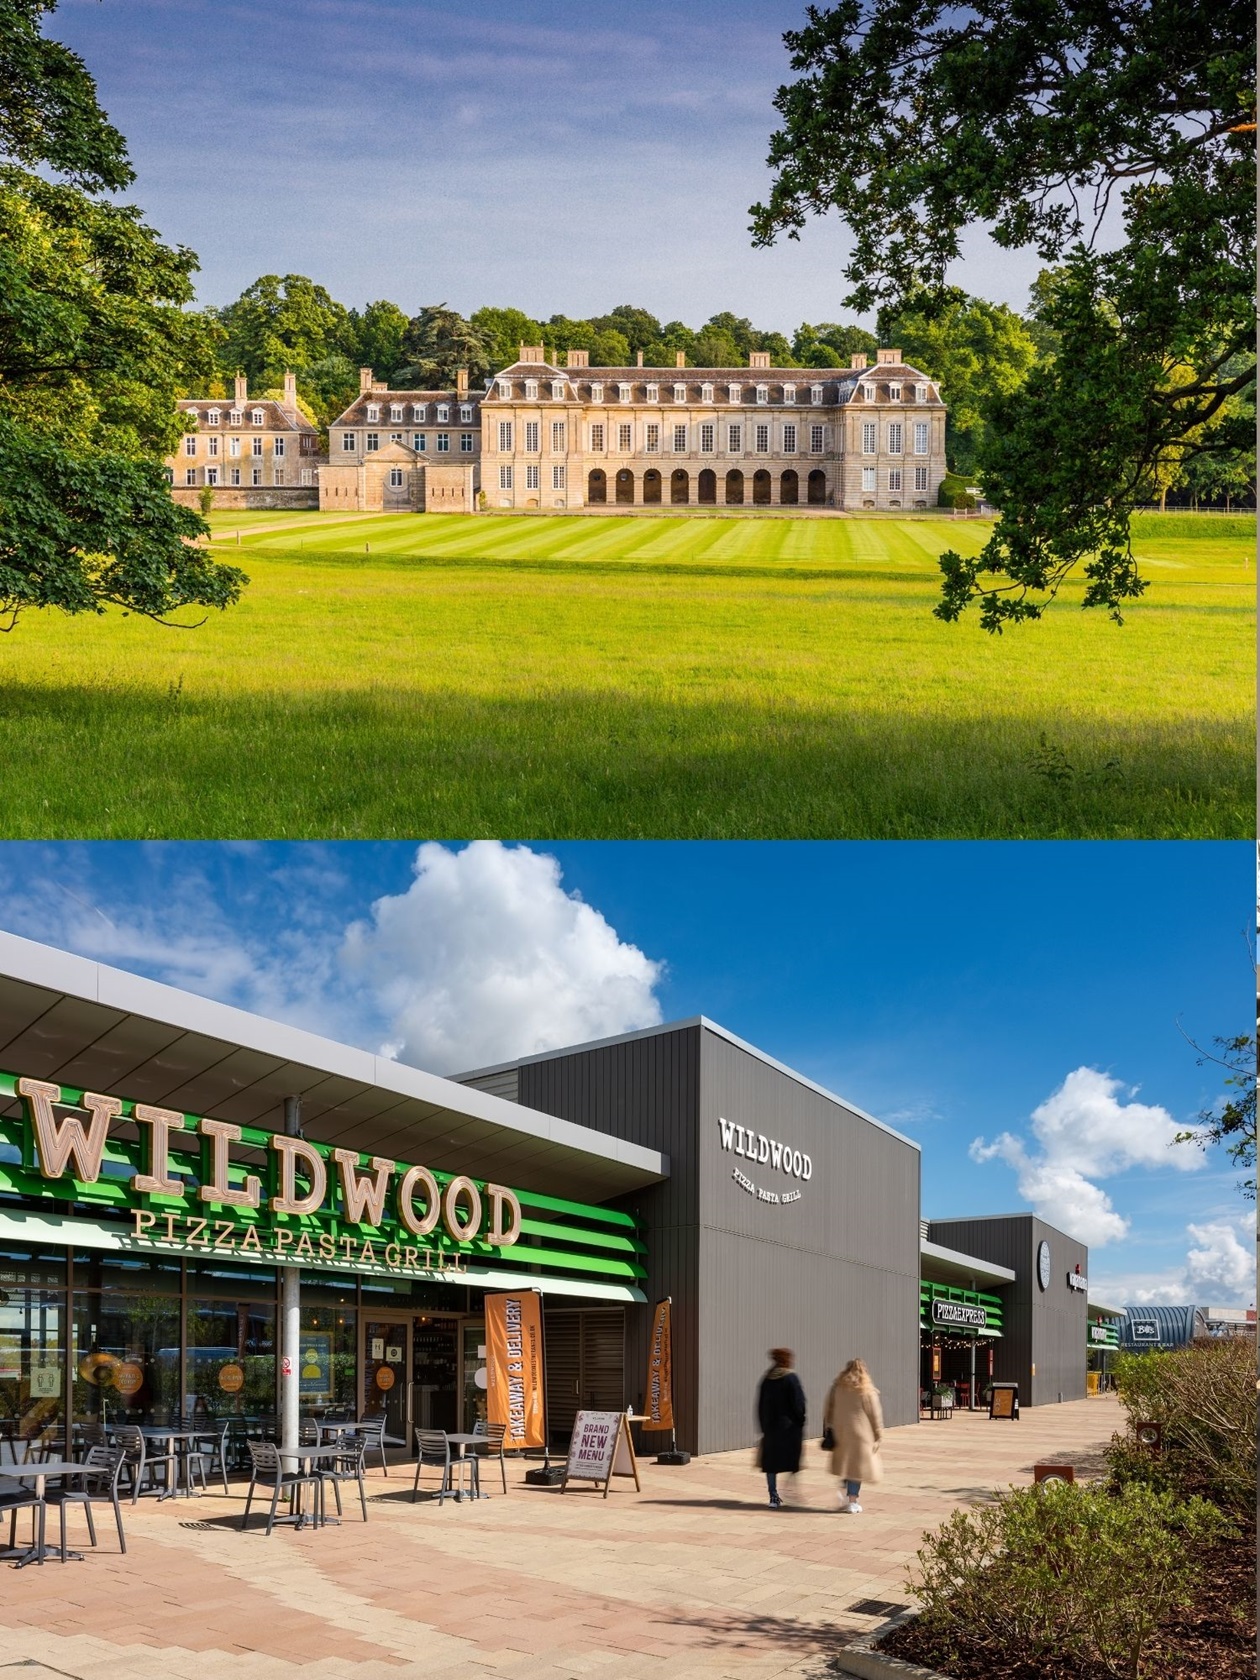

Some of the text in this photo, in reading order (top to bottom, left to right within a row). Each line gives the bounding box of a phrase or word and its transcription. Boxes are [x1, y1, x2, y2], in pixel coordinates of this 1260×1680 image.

[14, 1077, 522, 1246] WILDWOOD
[719, 1117, 812, 1181] WILDWOOD
[732, 1167, 801, 1203] PIZZA PASTA GRILL
[130, 1208, 467, 1275] PIZZA PASTA GRILL
[937, 1303, 985, 1325] PIZZAEXPRESS
[506, 1298, 526, 1441] TAKEAWAY & DELIVERY
[652, 1358, 661, 1367] &
[651, 1368, 661, 1425] TAKEAWAY
[580, 1434, 608, 1449] NEW
[583, 1423, 610, 1434] BRAND
[578, 1449, 605, 1462] MENU
